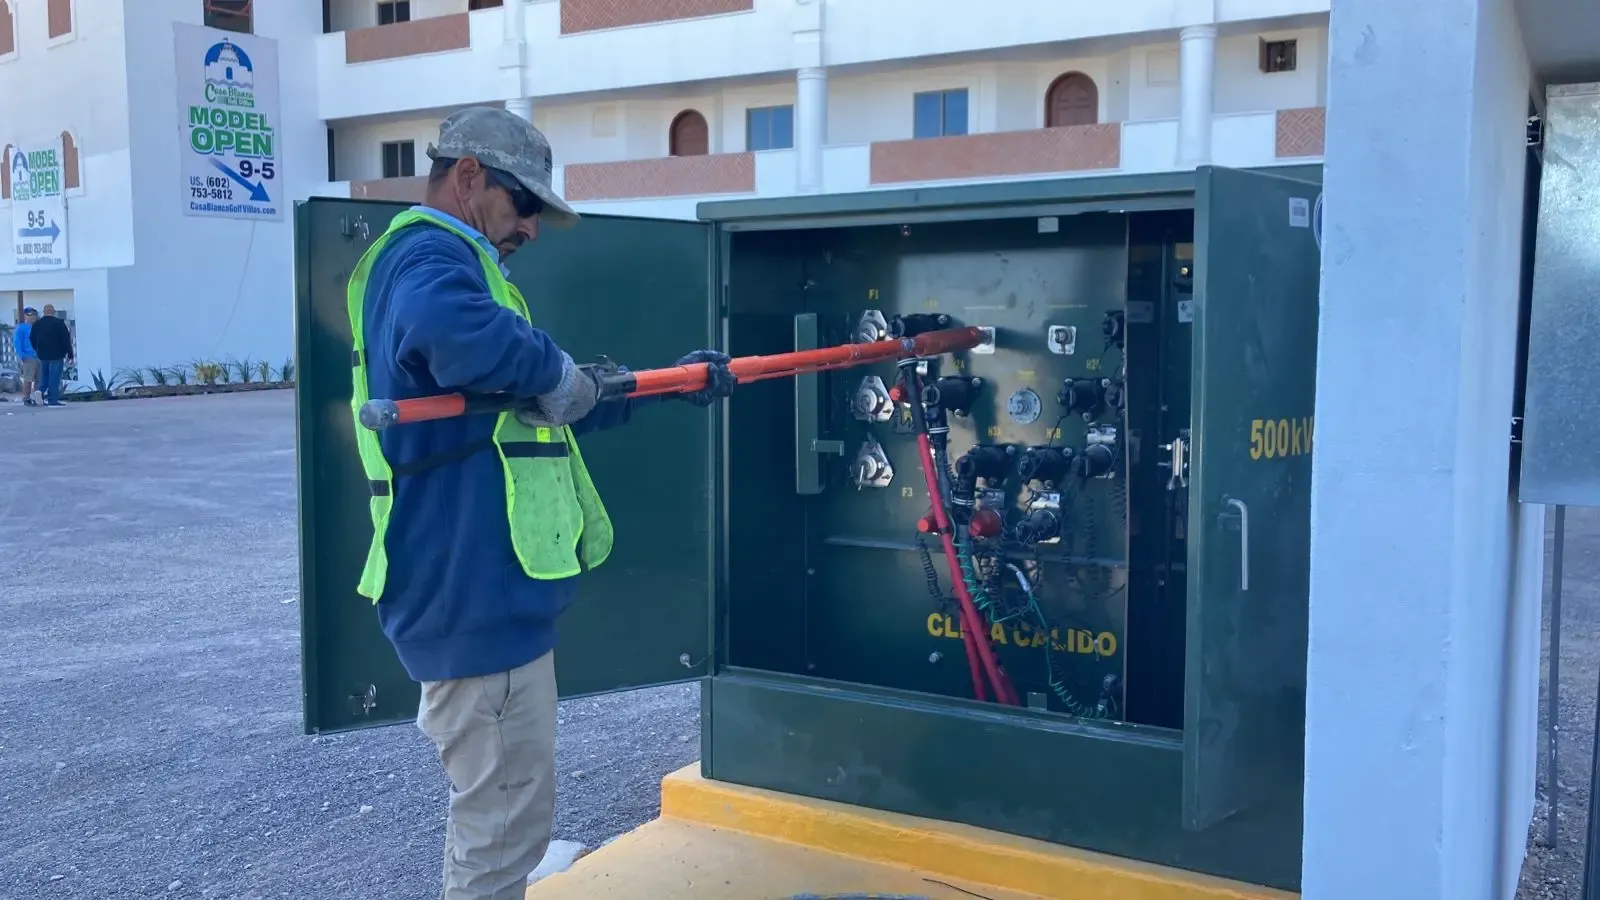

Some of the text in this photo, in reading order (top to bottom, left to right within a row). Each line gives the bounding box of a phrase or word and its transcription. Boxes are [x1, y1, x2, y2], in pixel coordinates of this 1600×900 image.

[205, 83, 227, 103] Casa
[189, 105, 273, 132] MODEL
[190, 127, 273, 157] OPEN
[28, 149, 58, 168] MODEL
[239, 160, 275, 179] 9-5
[29, 171, 60, 196] OPEN
[206, 176, 230, 189] (602)
[191, 187, 233, 200] 753-5812
[190, 201, 277, 214] CasaBlancaGolfVillas.com
[28, 210, 45, 228] 9-5
[868, 288, 879, 300] F1
[902, 487, 913, 498] F3
